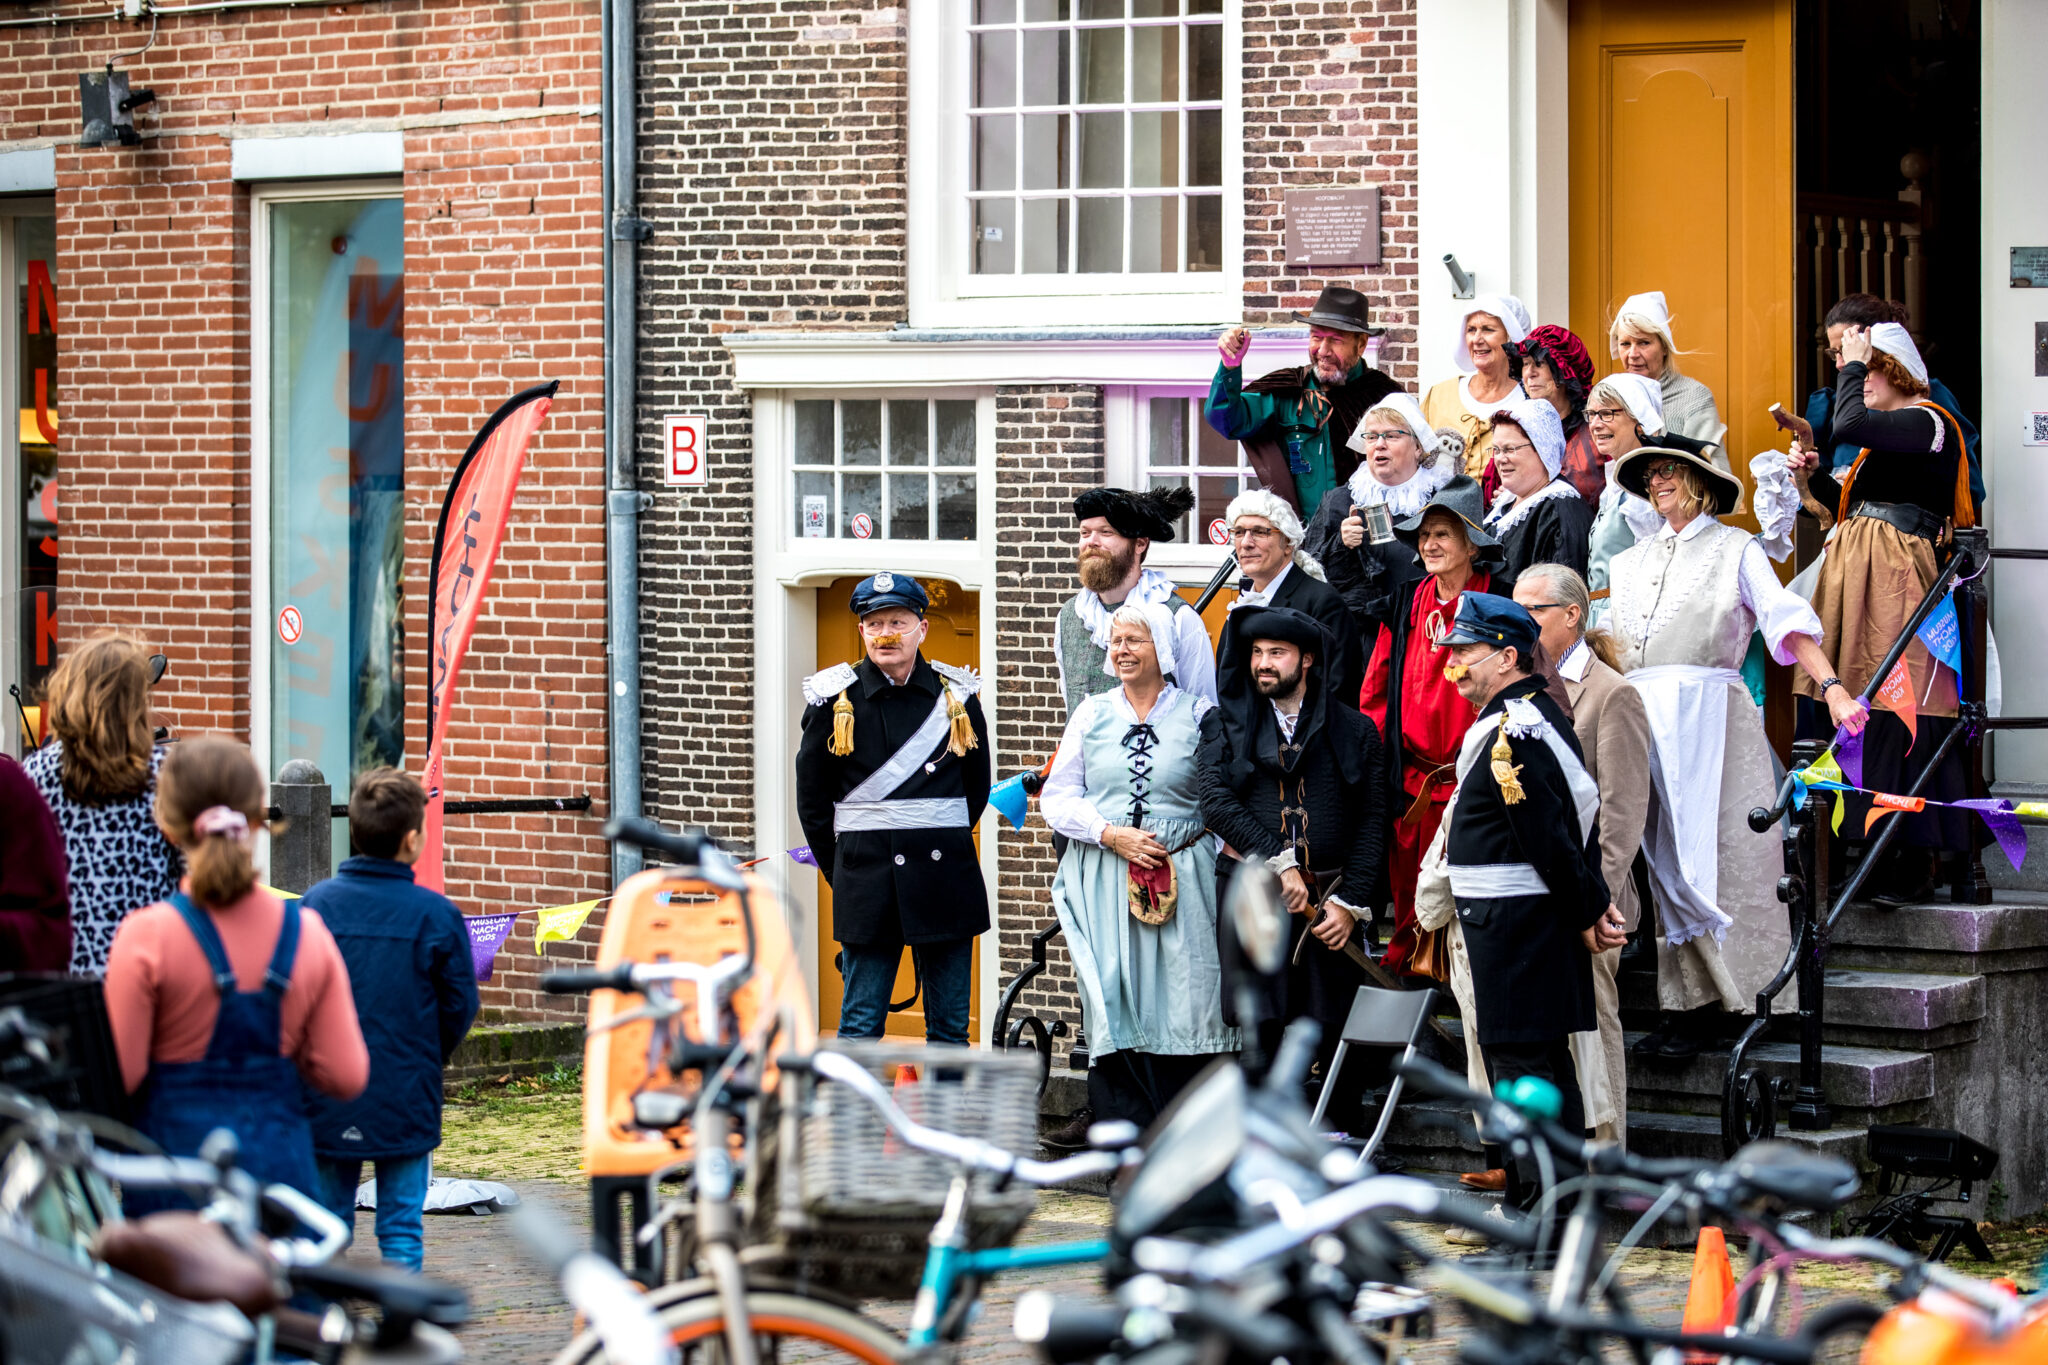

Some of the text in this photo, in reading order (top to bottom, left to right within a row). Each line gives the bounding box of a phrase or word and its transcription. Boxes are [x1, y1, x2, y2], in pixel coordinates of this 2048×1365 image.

[672, 426, 698, 475] B
[470, 916, 510, 927] MUSEUM
[471, 923, 506, 936] NACHT
[476, 933, 496, 942] KIDS
